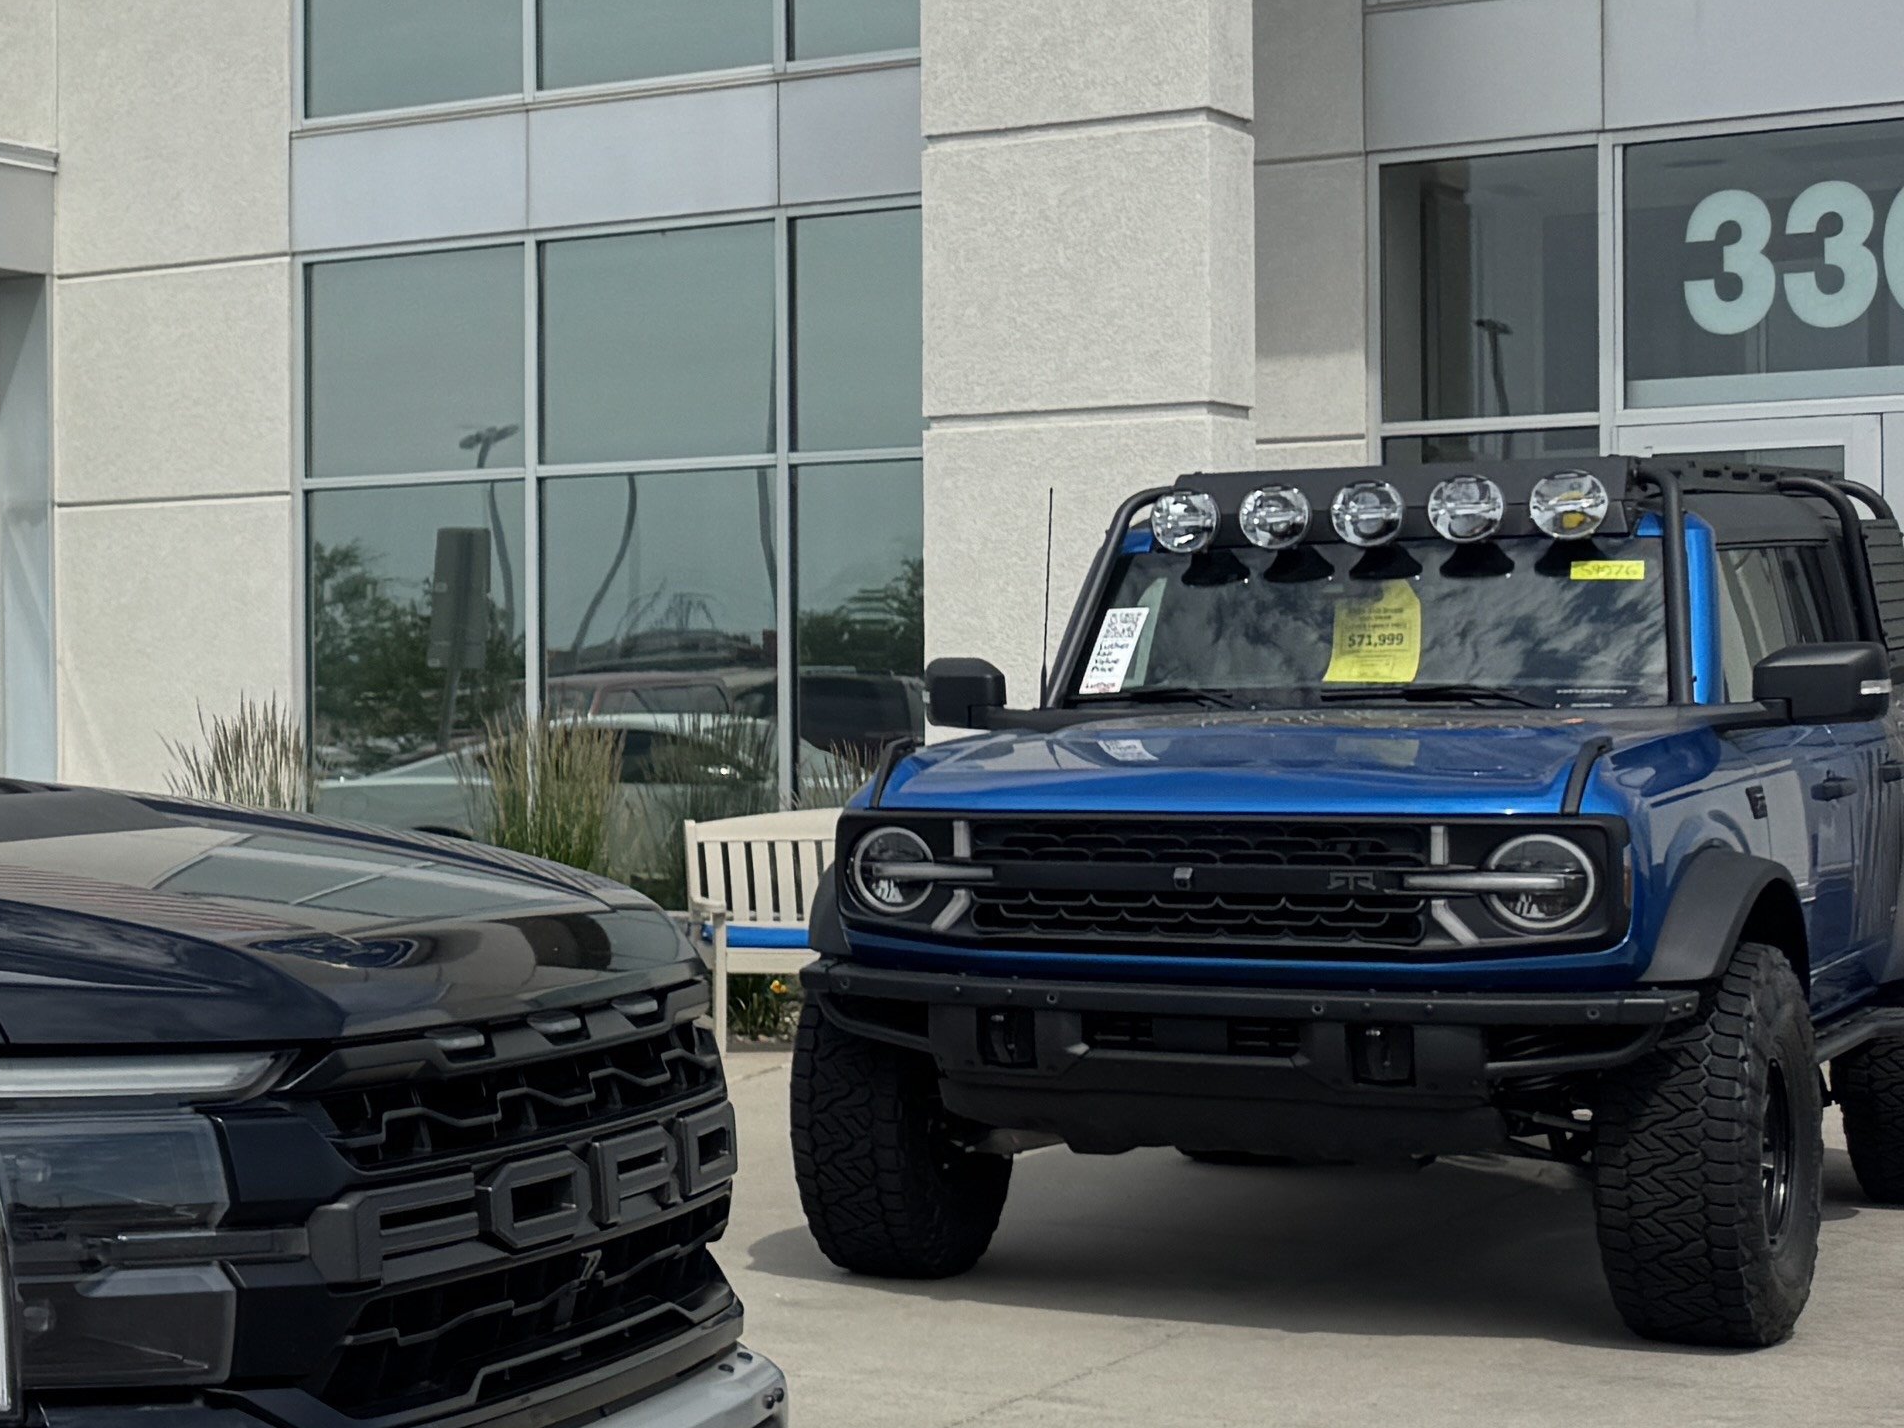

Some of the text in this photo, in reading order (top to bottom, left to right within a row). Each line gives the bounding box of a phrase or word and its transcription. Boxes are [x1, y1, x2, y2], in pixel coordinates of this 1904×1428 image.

[1683, 179, 1904, 336] 33
[1348, 632, 1404, 649] $71,999
[307, 1100, 739, 1296] FORD
